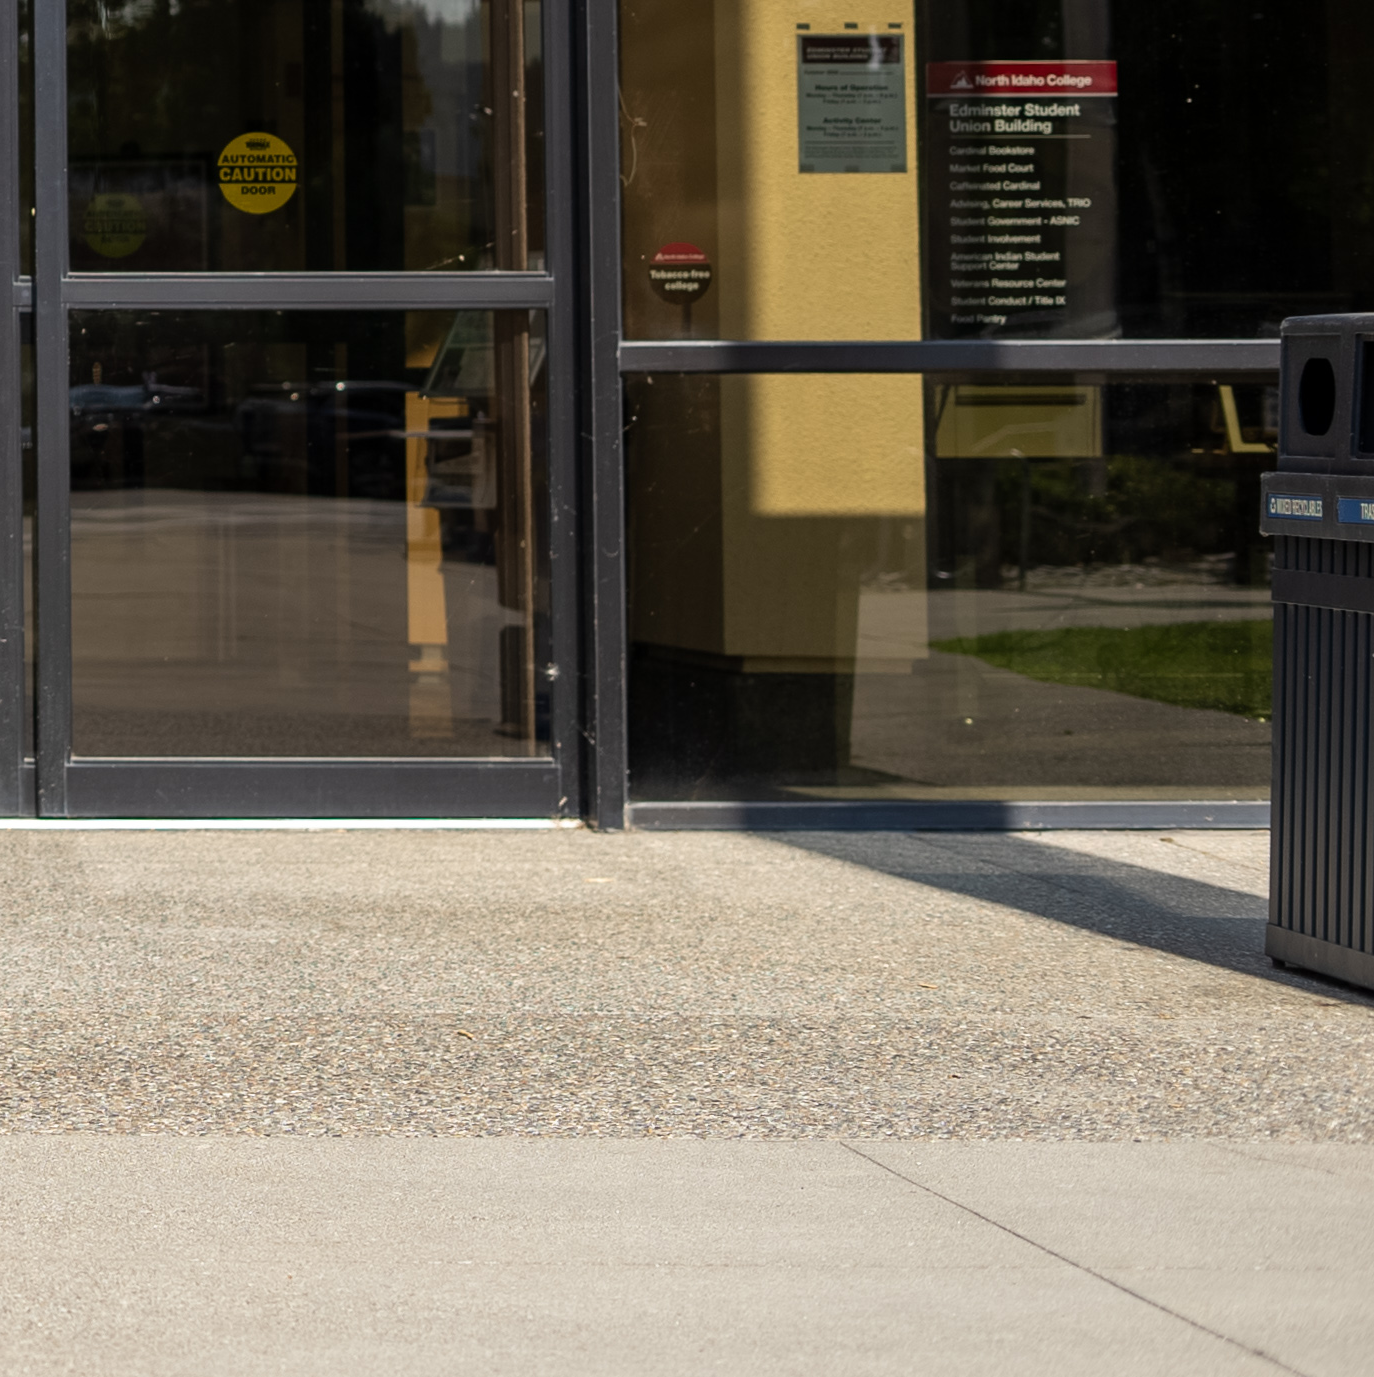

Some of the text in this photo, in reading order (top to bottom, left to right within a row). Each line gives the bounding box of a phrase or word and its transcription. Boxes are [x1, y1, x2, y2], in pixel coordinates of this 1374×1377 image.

[975, 74, 1093, 88] North Idaho College
[949, 103, 1081, 117] Edminster Student
[949, 119, 1053, 135] Union Building
[949, 145, 1035, 155] Cardinal Bookstore
[221, 154, 295, 164] AUTOMATIC
[983, 163, 1006, 173] Food
[1008, 163, 1034, 173] Court
[219, 167, 297, 182] CAUTION
[240, 186, 277, 195] DOOR
[949, 180, 1041, 191] Caffeinated Cardinal
[992, 198, 1023, 208] Career
[1024, 198, 1067, 209] Services,
[1067, 198, 1092, 208] TRIO
[950, 216, 986, 226] Student
[987, 216, 1042, 226] Government
[950, 234, 1041, 244] Student Involvement
[951, 251, 1060, 261] American Indian Student
[951, 261, 1020, 272] Support Center
[649, 269, 711, 280] Tobacco-free
[664, 281, 700, 292] college
[950, 278, 1067, 288] Veterans Resource Center
[951, 296, 986, 306] Student
[988, 296, 1027, 306] Conduct
[1034, 295, 1054, 306] Title
[1055, 296, 1066, 306] IX
[951, 314, 1007, 326] Food Pantry
